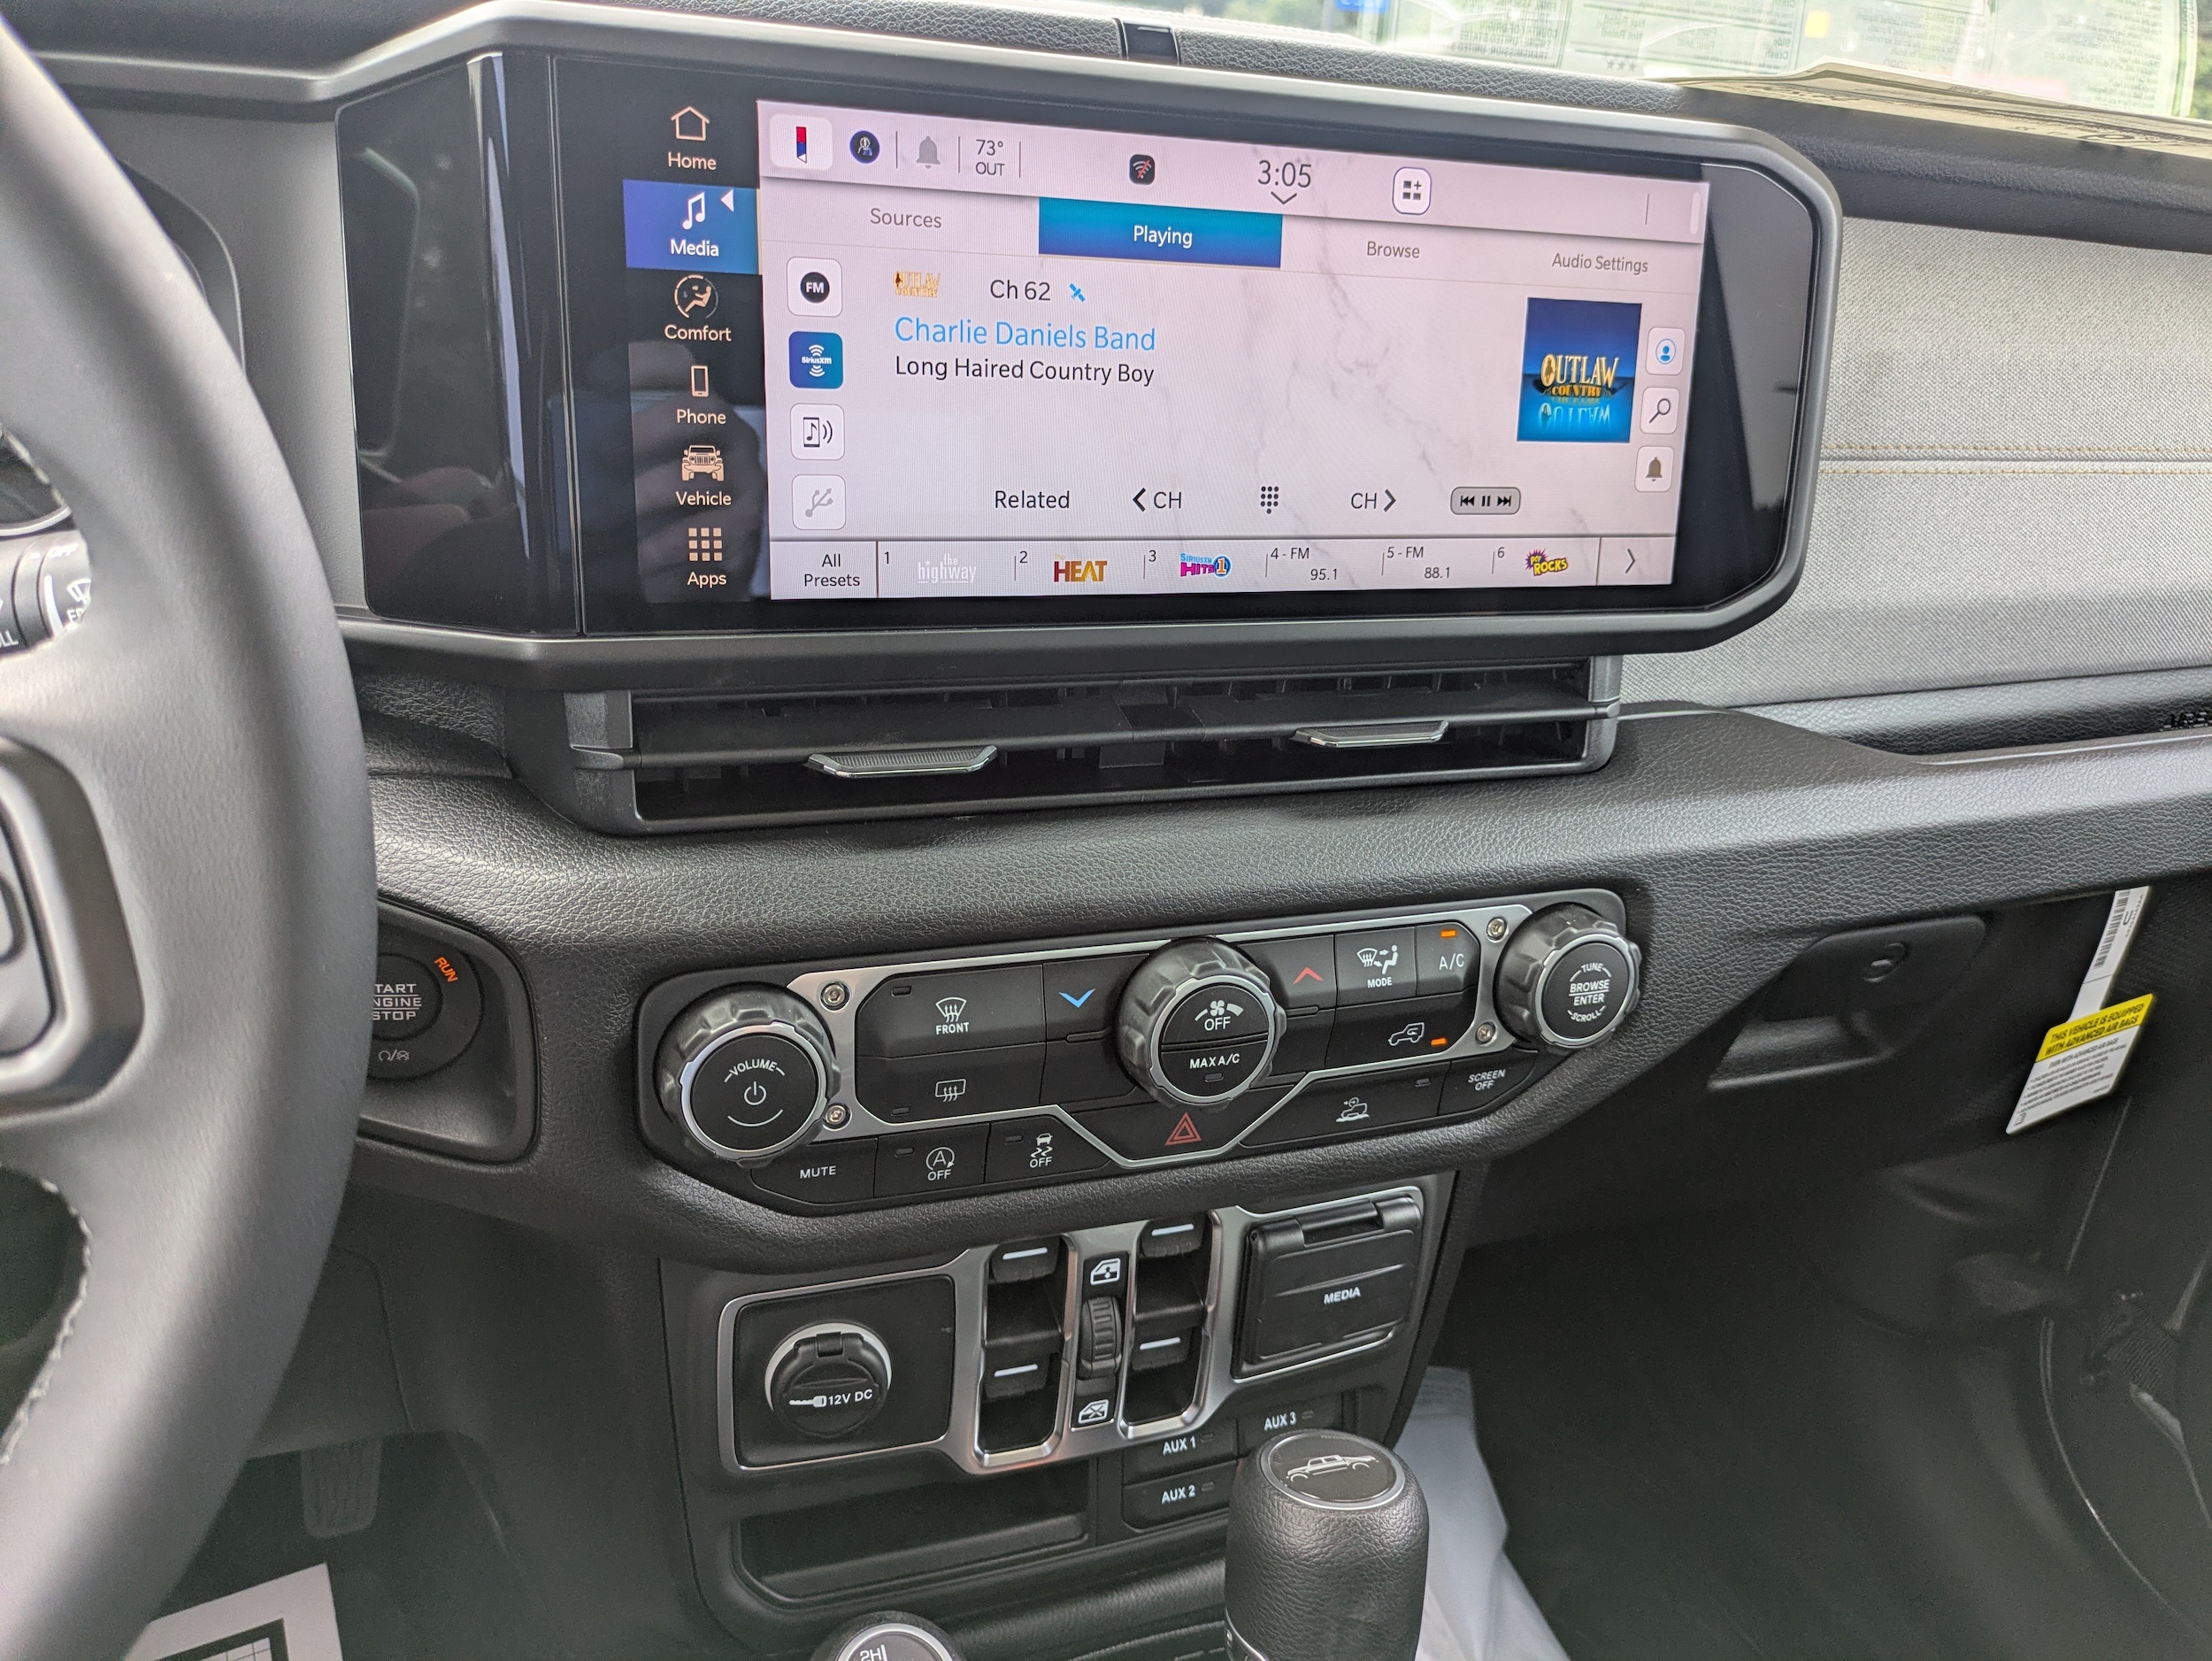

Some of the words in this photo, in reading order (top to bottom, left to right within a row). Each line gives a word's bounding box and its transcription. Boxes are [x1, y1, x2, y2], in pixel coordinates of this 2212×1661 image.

[668, 152, 717, 172] Home
[975, 162, 1006, 177] OUT
[1256, 159, 1313, 190] 3:05
[870, 208, 942, 229] Sources
[1133, 225, 1193, 250] Playing
[670, 239, 719, 258] Media
[1366, 241, 1420, 260] Browse
[1552, 253, 1593, 273] Audio
[1595, 256, 1649, 277] Settings
[805, 281, 825, 296] FM
[989, 280, 1019, 301] Ch
[1024, 281, 1051, 303] 62
[664, 324, 732, 342] Comfort
[895, 317, 988, 346] Charlie
[995, 322, 1087, 349] Daniels
[1094, 327, 1156, 351] Band
[895, 356, 949, 381] Long
[955, 358, 1024, 380] Haired
[1029, 361, 1112, 386] Country
[1118, 365, 1155, 387] Boy
[1540, 353, 1619, 388] OUTLAW
[1551, 384, 1602, 397] COUNTRY
[676, 409, 726, 426] Phone
[676, 490, 732, 507] Vehicle
[995, 490, 1071, 510] Related
[1154, 492, 1182, 510] CH
[1350, 492, 1378, 510] CH
[821, 553, 841, 568] All
[1019, 550, 1028, 564] 2
[1148, 550, 1156, 563] 3
[1270, 548, 1279, 561] 4
[1289, 548, 1310, 560] FM
[1386, 547, 1394, 559] 5
[1404, 546, 1425, 559] FM
[1497, 547, 1505, 559] 6
[918, 560, 977, 584] highway
[1054, 560, 1108, 582] HEAT
[1310, 568, 1338, 581] 95.1
[1424, 566, 1450, 580] 88.1
[1533, 558, 1568, 576] ROCKS
[687, 572, 727, 589] Apps
[803, 573, 861, 589] Presets
[434, 956, 458, 982] RUN
[1438, 952, 1465, 972] A/C
[1580, 962, 1604, 973] TUNE
[375, 983, 417, 994] TART
[1367, 977, 1393, 988] MODE
[1570, 979, 1610, 993] BROWSE
[373, 996, 423, 1007] NGINE
[1573, 993, 1605, 1006] ENTER
[372, 1011, 417, 1020] STOP
[1204, 1016, 1231, 1032] OFF
[1571, 1010, 1601, 1022] SCROLL
[2051, 1029, 2068, 1043] THIS
[2069, 1016, 2101, 1035] VEHICLE
[2099, 1015, 2108, 1026] IS
[2108, 1003, 2145, 1023] EQUIPPED
[935, 1021, 970, 1035] FRONT
[2045, 1042, 2064, 1057] WITH
[2064, 1027, 2106, 1050] ADVANCED
[2106, 1021, 2119, 1033] AIR
[2119, 1015, 2140, 1027] BAGS
[730, 1059, 776, 1075] VOLUME
[1189, 1056, 1217, 1069] MAX
[1218, 1052, 1240, 1067] A/C
[1467, 1069, 1506, 1085] SCREEN
[1474, 1080, 1494, 1092] OFF
[1029, 1155, 1053, 1169] OFF
[800, 1165, 836, 1179] MUTE
[927, 1168, 951, 1181] OFF
[1324, 1287, 1361, 1305] MEDIA
[827, 1391, 851, 1407] 12V
[854, 1388, 873, 1403] DC
[1263, 1415, 1289, 1431] AUX
[1290, 1411, 1297, 1426] 3
[1163, 1440, 1188, 1455] AUX
[1190, 1436, 1196, 1450] 1
[1161, 1488, 1187, 1504] AUX
[1187, 1484, 1195, 1498] 2
